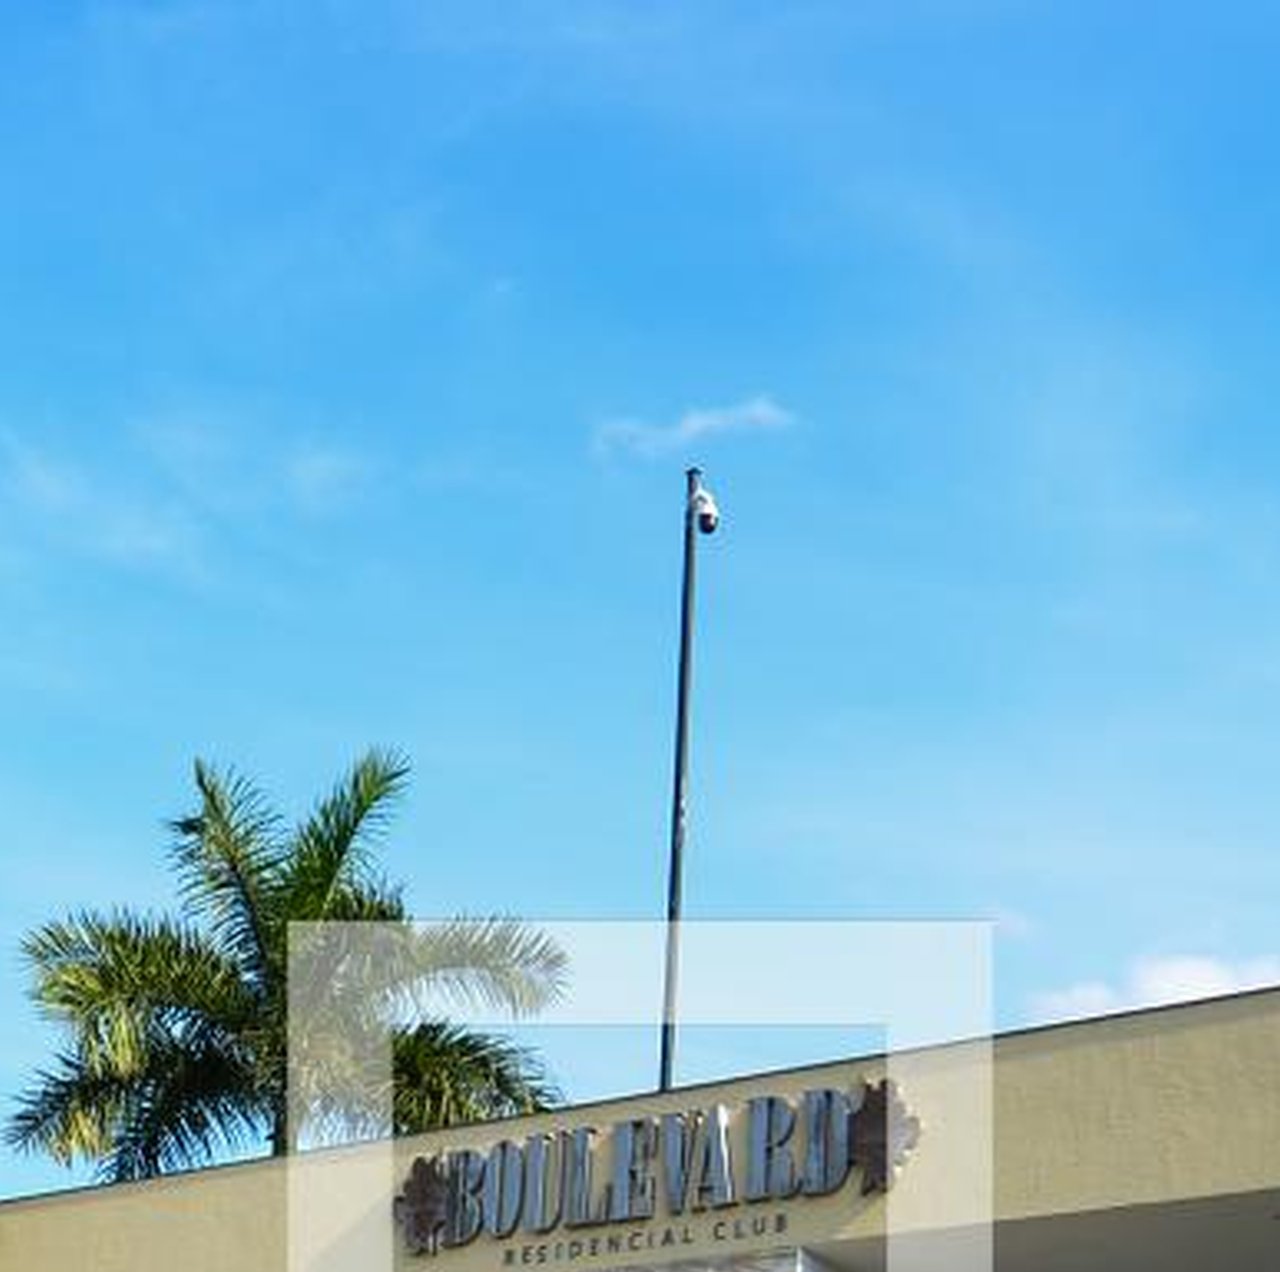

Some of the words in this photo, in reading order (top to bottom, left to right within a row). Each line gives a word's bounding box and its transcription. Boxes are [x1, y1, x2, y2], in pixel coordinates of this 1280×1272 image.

[444, 1088, 854, 1249] BOULEVARD
[503, 1227, 693, 1265] RESIDENCIAL
[712, 1213, 788, 1241] CLUB
